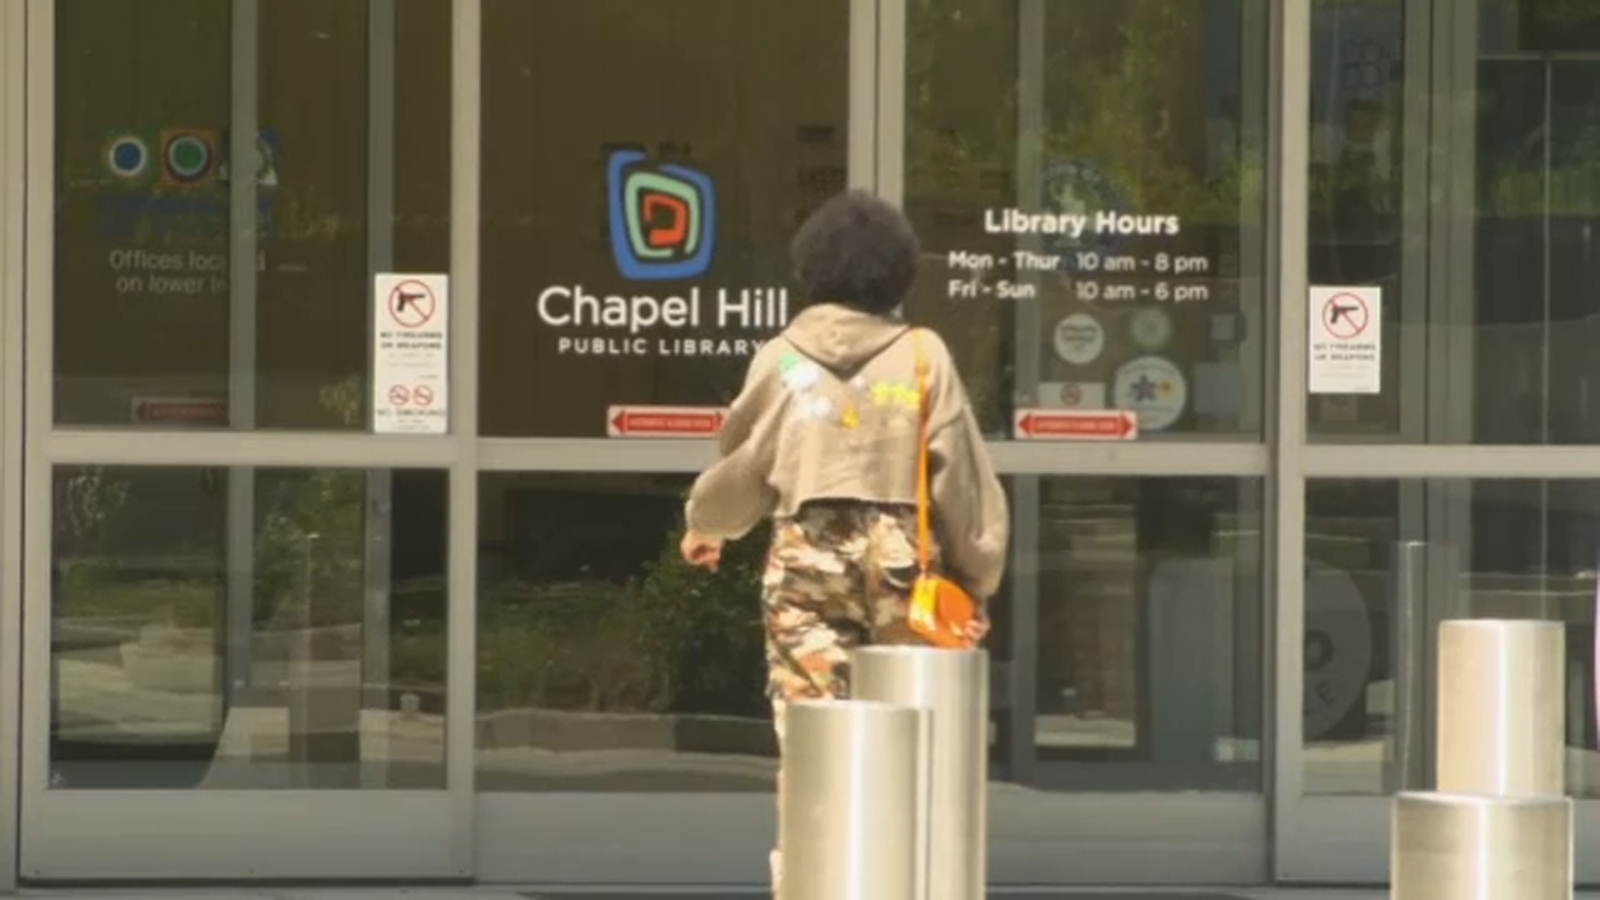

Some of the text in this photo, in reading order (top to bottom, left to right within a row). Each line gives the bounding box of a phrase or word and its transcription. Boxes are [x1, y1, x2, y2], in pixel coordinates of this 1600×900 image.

[984, 209, 1180, 238] Library Hours
[109, 249, 184, 271] Offices
[949, 251, 993, 270] Mon
[1013, 251, 1060, 271] Thur
[1076, 253, 1098, 271] 10
[1104, 256, 1135, 272] am
[1154, 253, 1169, 272] 8
[1174, 256, 1209, 274] pm
[116, 276, 143, 293] on
[149, 273, 205, 294] lower
[949, 279, 976, 298] Fri
[996, 280, 1036, 299] Sun
[1075, 282, 1098, 300] 10
[1104, 285, 1135, 300] am
[1154, 282, 1169, 300] 6
[1174, 285, 1209, 303] pm
[537, 285, 788, 334] Chapel Hill
[558, 337, 765, 356] PUBLIC LIBRARY
